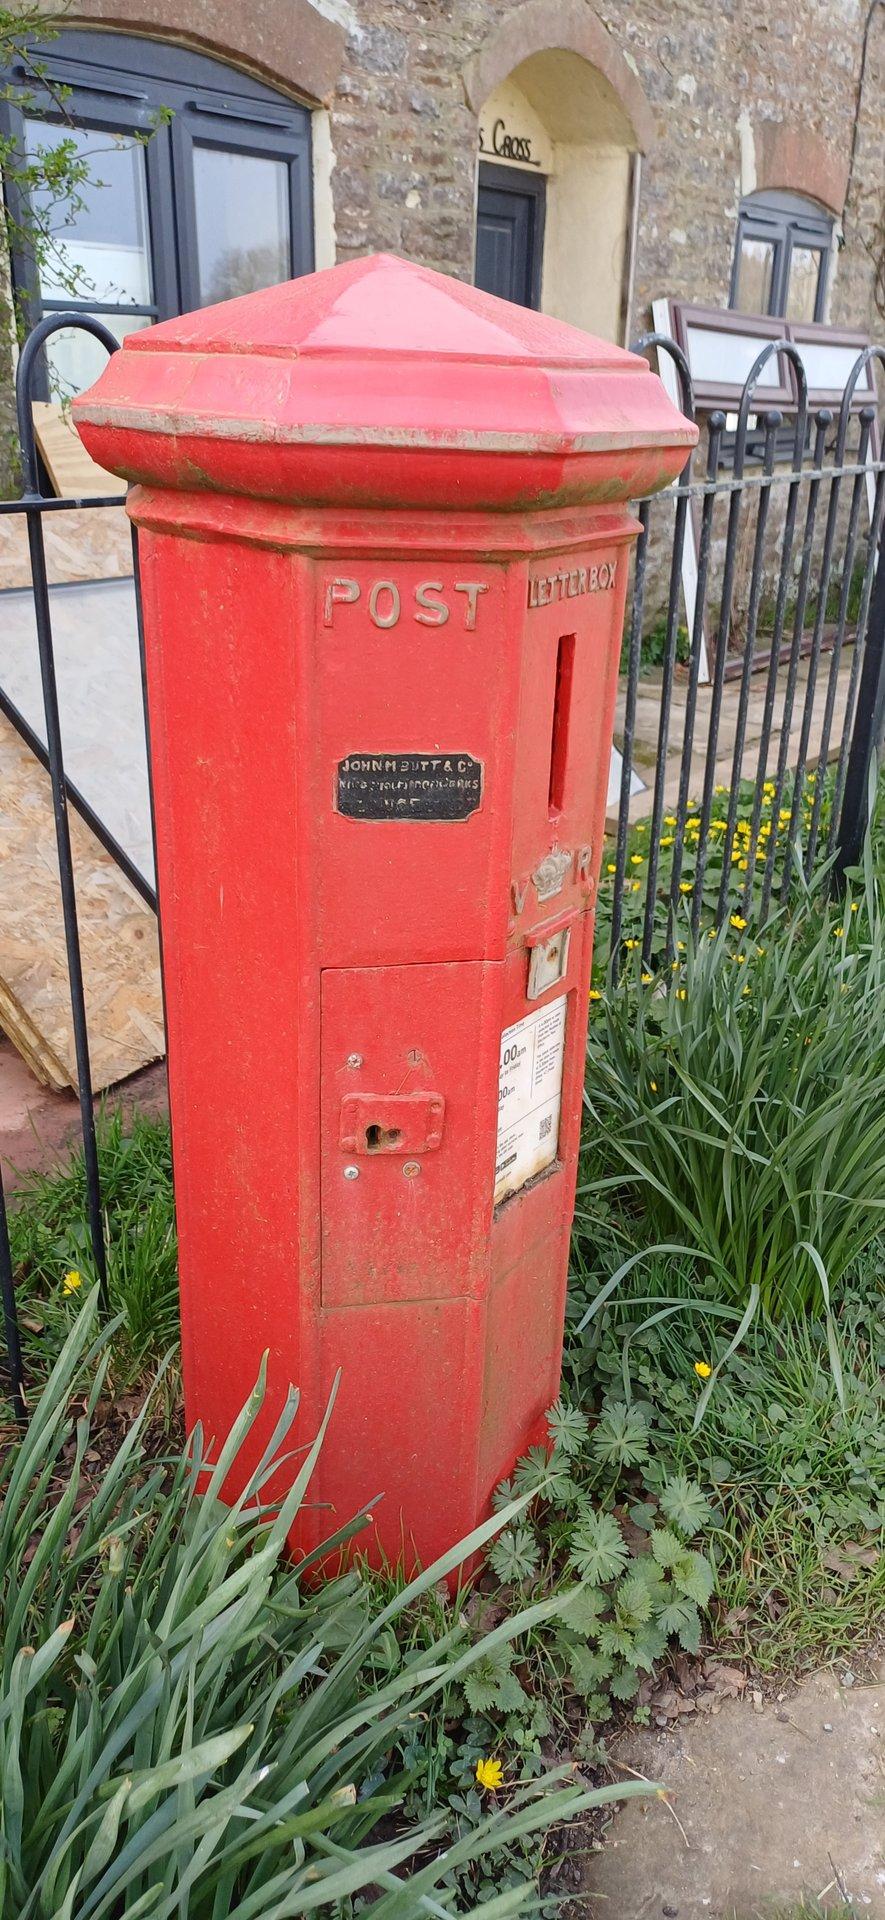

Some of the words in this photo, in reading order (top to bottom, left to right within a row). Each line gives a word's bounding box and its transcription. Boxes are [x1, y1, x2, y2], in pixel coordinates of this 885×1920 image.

[323, 577, 489, 631] POST
[529, 568, 588, 607] LETTER
[588, 560, 618, 592] BOX
[342, 759, 382, 772] JOHN
[400, 759, 442, 772] BUTT
[443, 760, 454, 772] &
[512, 877, 530, 914] V
[576, 845, 595, 897] R
